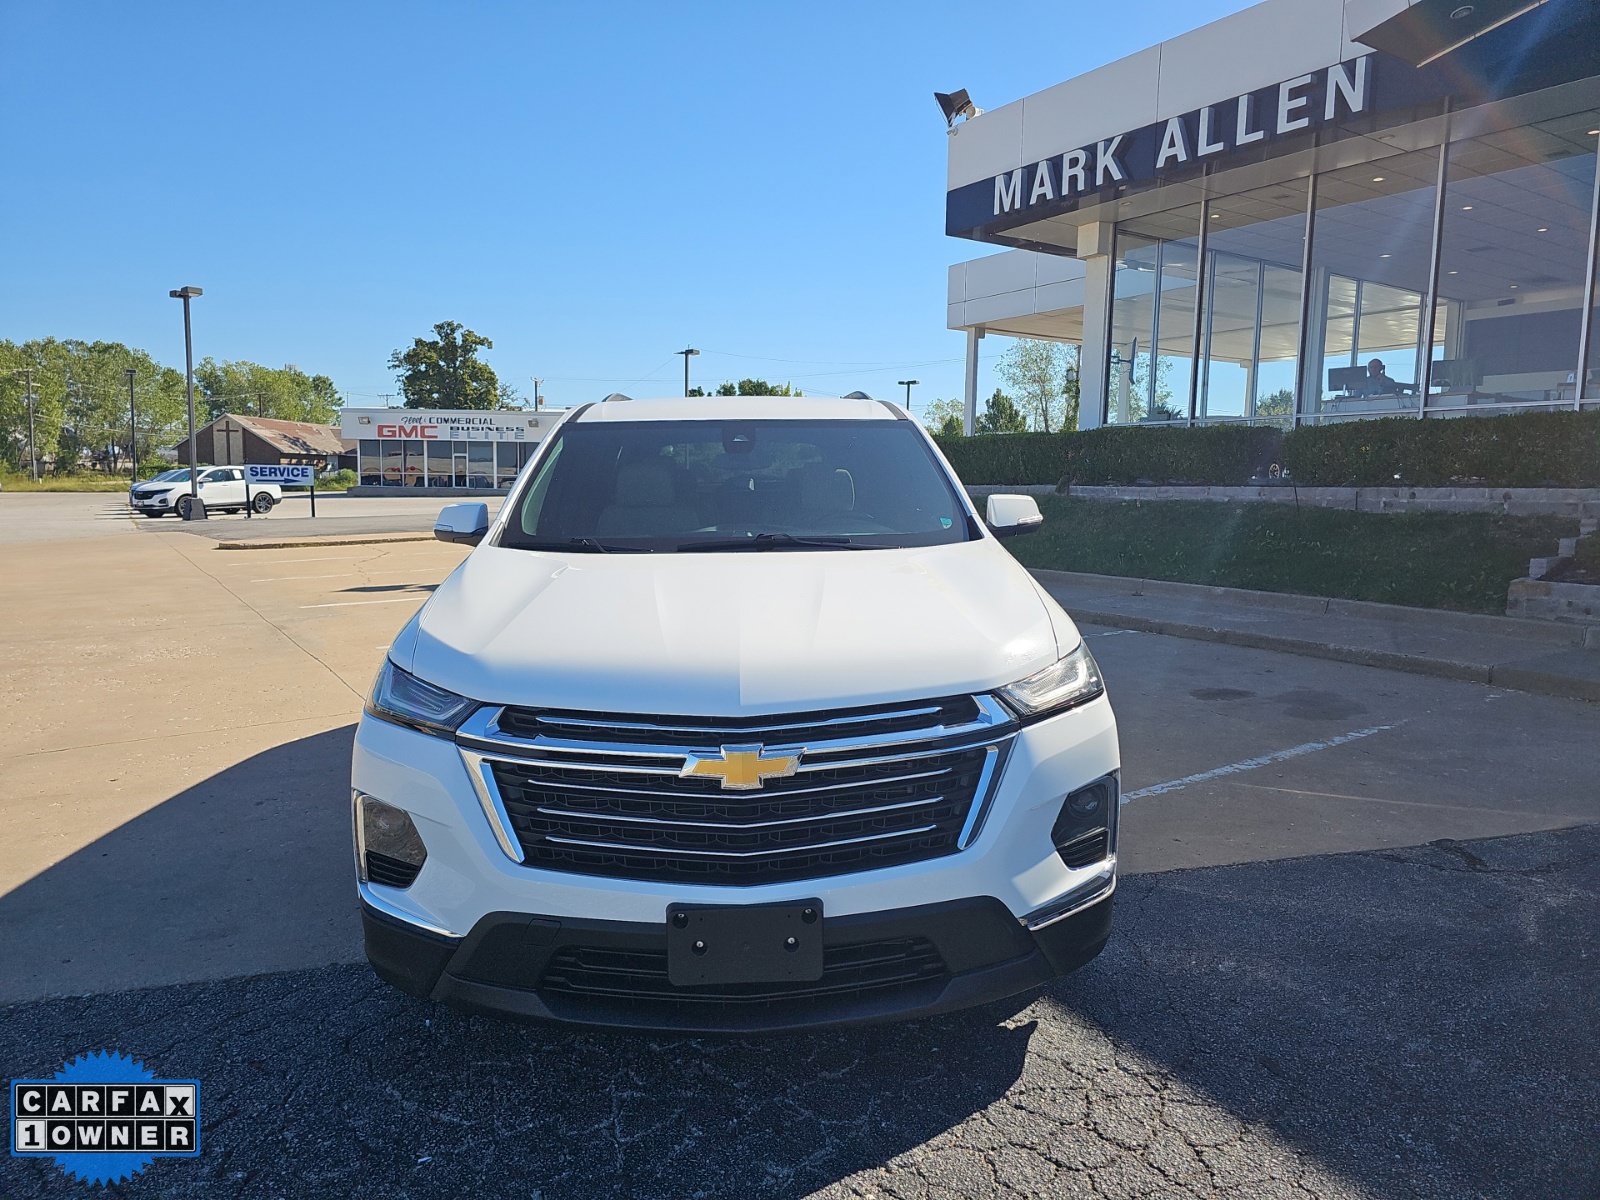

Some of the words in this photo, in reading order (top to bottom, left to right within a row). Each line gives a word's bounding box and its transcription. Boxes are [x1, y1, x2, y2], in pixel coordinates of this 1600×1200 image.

[993, 134, 1126, 215] MARK
[1156, 56, 1371, 169] ALLEN
[428, 417, 496, 425] COMMERCIAL
[377, 424, 438, 438] GMC
[450, 431, 525, 439] ELITE
[250, 466, 309, 478] SERVICE
